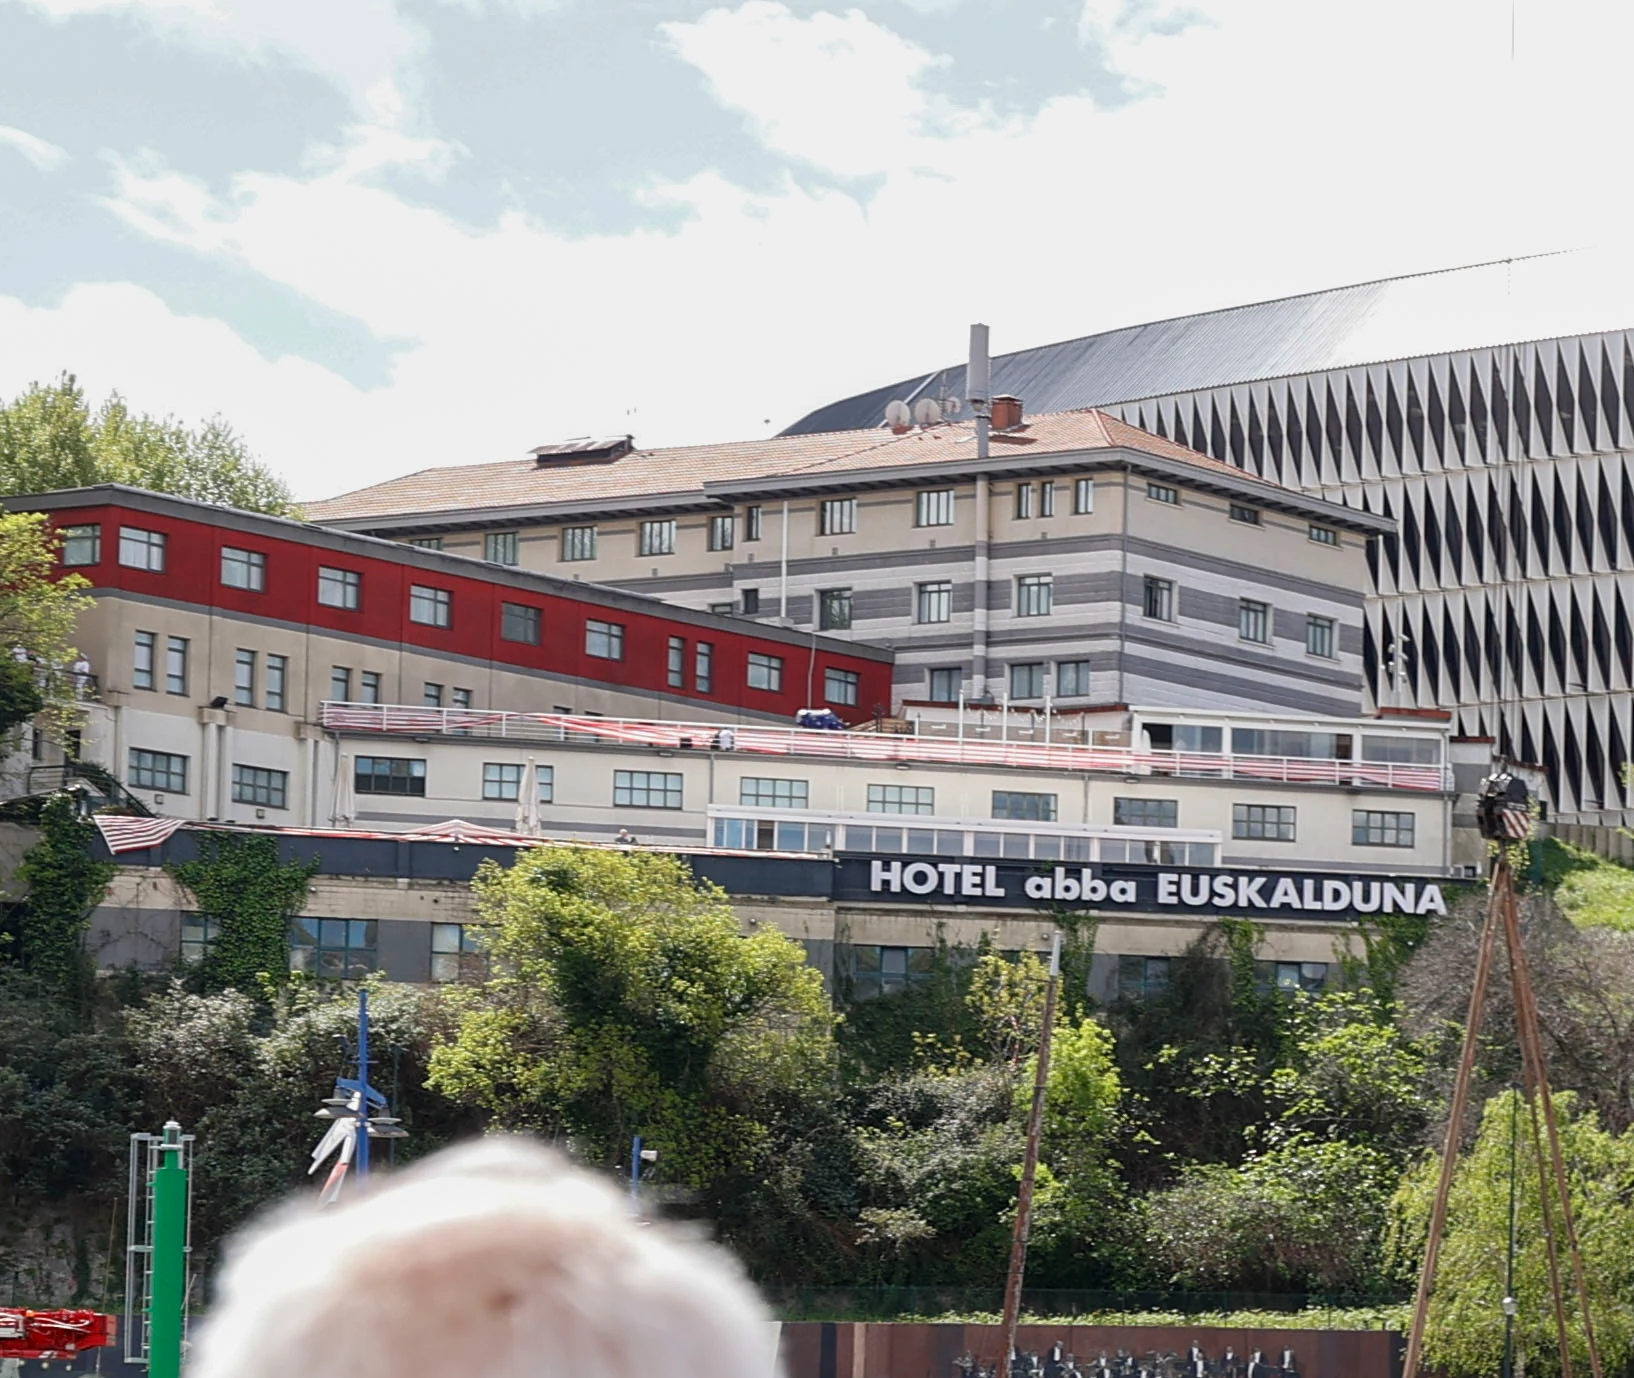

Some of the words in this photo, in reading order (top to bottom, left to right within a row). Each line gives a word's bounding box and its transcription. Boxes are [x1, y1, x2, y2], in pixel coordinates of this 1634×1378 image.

[870, 860, 1005, 898] HOTEL
[1024, 866, 1137, 903] abba
[1157, 872, 1448, 916] EUSKALDUNA
